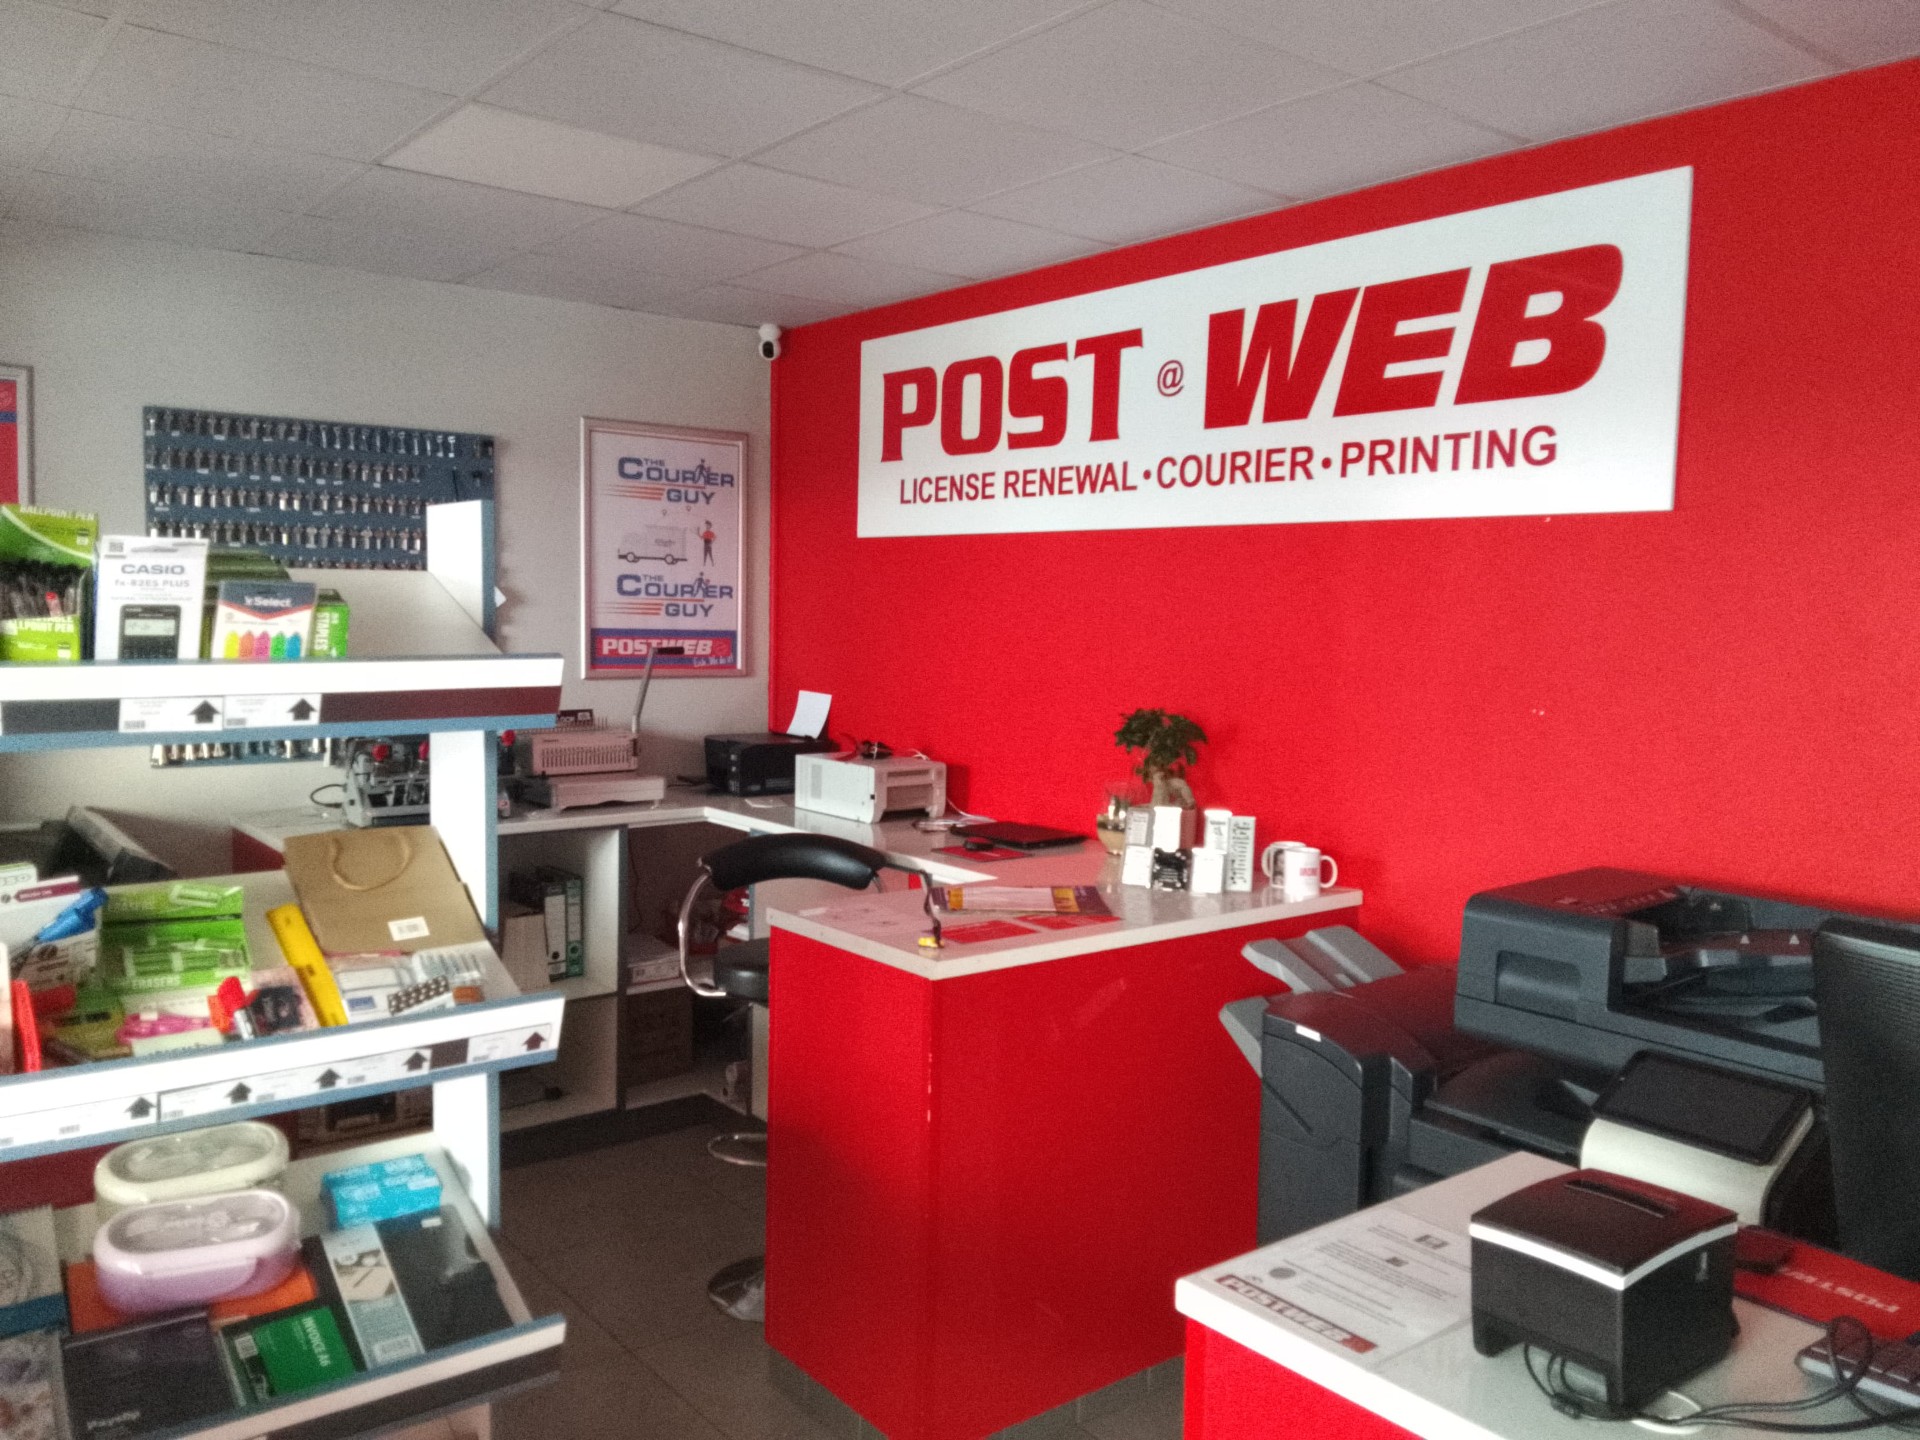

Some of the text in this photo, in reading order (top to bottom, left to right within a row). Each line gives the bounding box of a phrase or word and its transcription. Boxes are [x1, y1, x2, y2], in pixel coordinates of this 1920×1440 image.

[881, 244, 1623, 462] POST @ WEB
[644, 458, 666, 467] THE
[900, 425, 1558, 504] LICENSE RENEWAL COURIER PRINTING
[667, 488, 716, 505] GUY
[121, 564, 186, 575] CASIO
[163, 580, 191, 588] PLUS
[643, 574, 664, 583] THE
[665, 603, 714, 617] GUY
